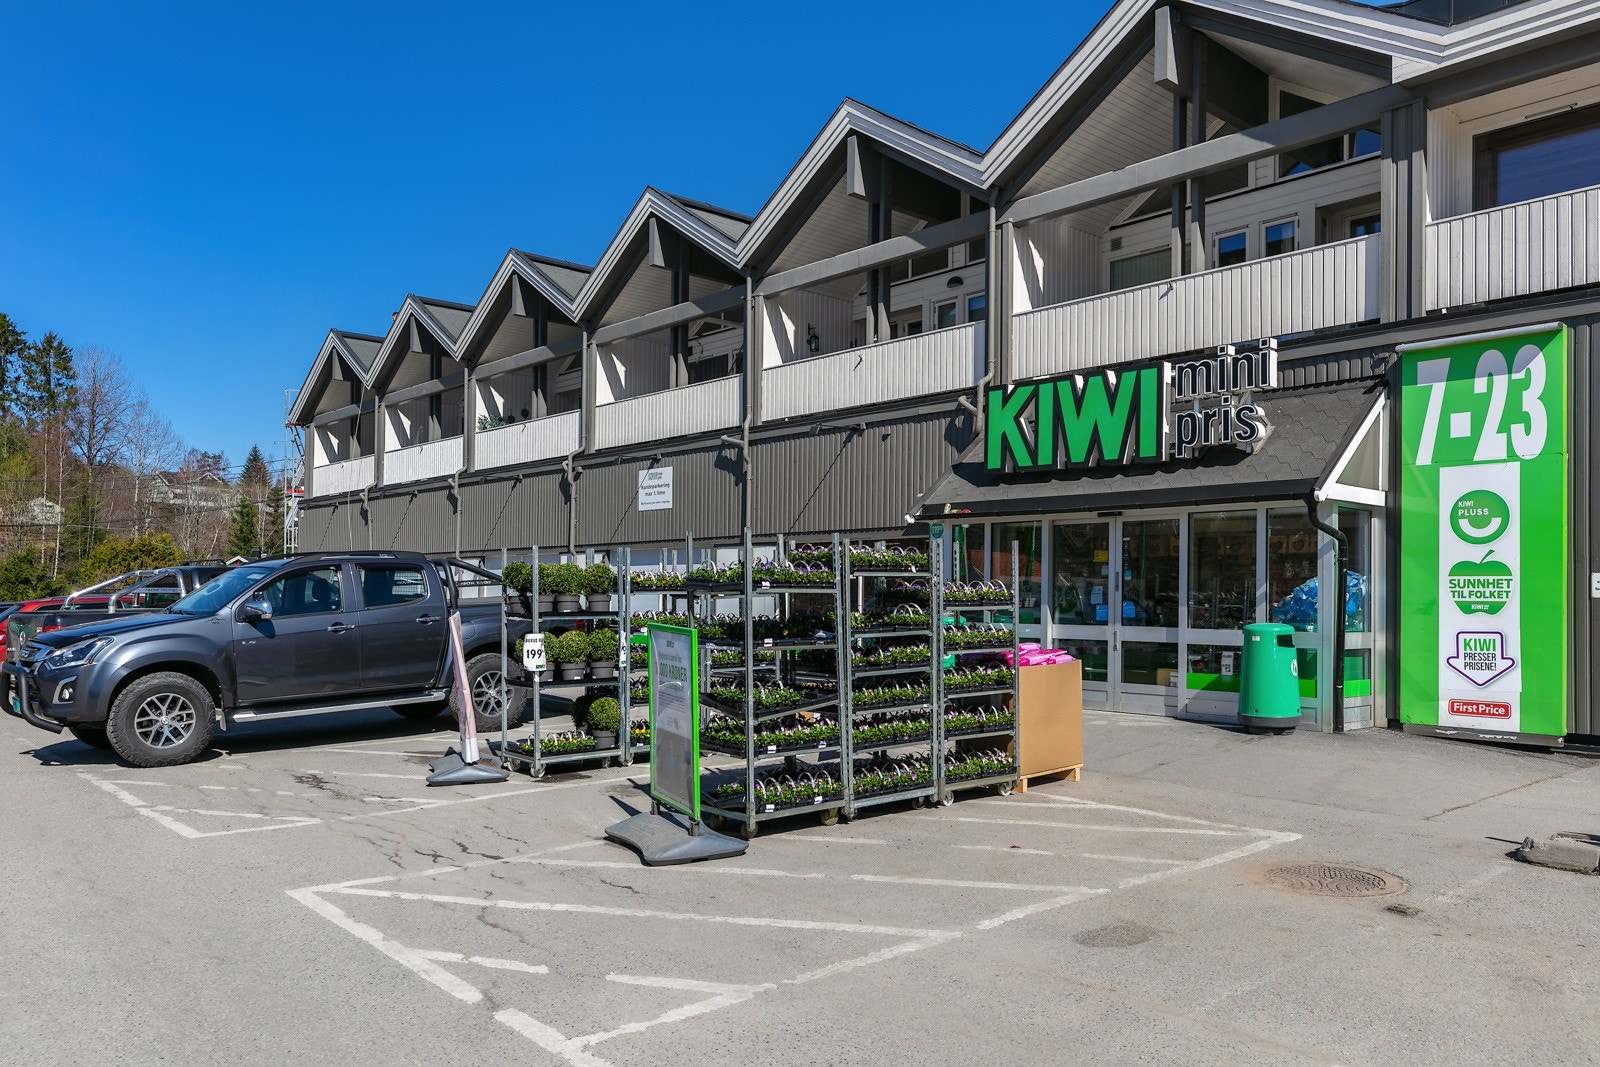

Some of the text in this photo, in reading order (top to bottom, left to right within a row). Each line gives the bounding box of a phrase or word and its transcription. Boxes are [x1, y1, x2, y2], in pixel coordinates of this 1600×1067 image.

[1174, 337, 1276, 398] mini
[1415, 343, 1548, 466] 7-23
[986, 365, 1162, 472] KIWI
[1174, 395, 1261, 459] pris
[1458, 500, 1474, 508] KIWI
[1458, 508, 1489, 516] PLUSS
[1448, 578, 1514, 590] SUNNHET
[1450, 590, 1512, 599] TIL FOLKET
[1463, 638, 1497, 652] KIWI
[526, 648, 543, 659] 199
[1463, 652, 1497, 662] PRESSER
[1463, 661, 1497, 672] PRISENE!
[1453, 702, 1506, 715] First Price
